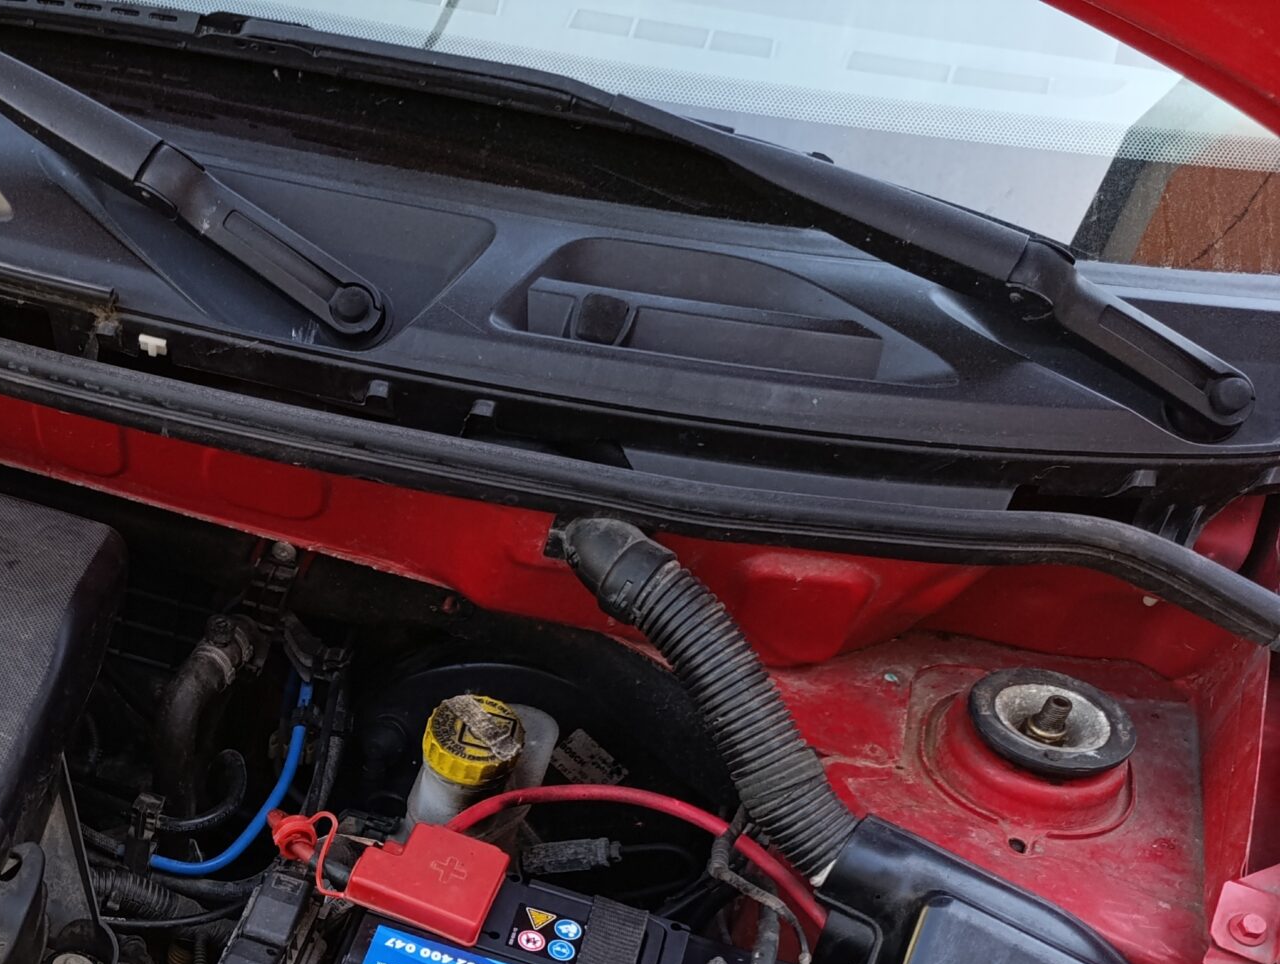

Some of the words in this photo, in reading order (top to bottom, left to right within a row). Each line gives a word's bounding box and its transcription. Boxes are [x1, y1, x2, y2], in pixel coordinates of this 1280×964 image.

[558, 741, 586, 767] BOSCH
[383, 935, 417, 954] 047
[419, 946, 454, 964] 400
